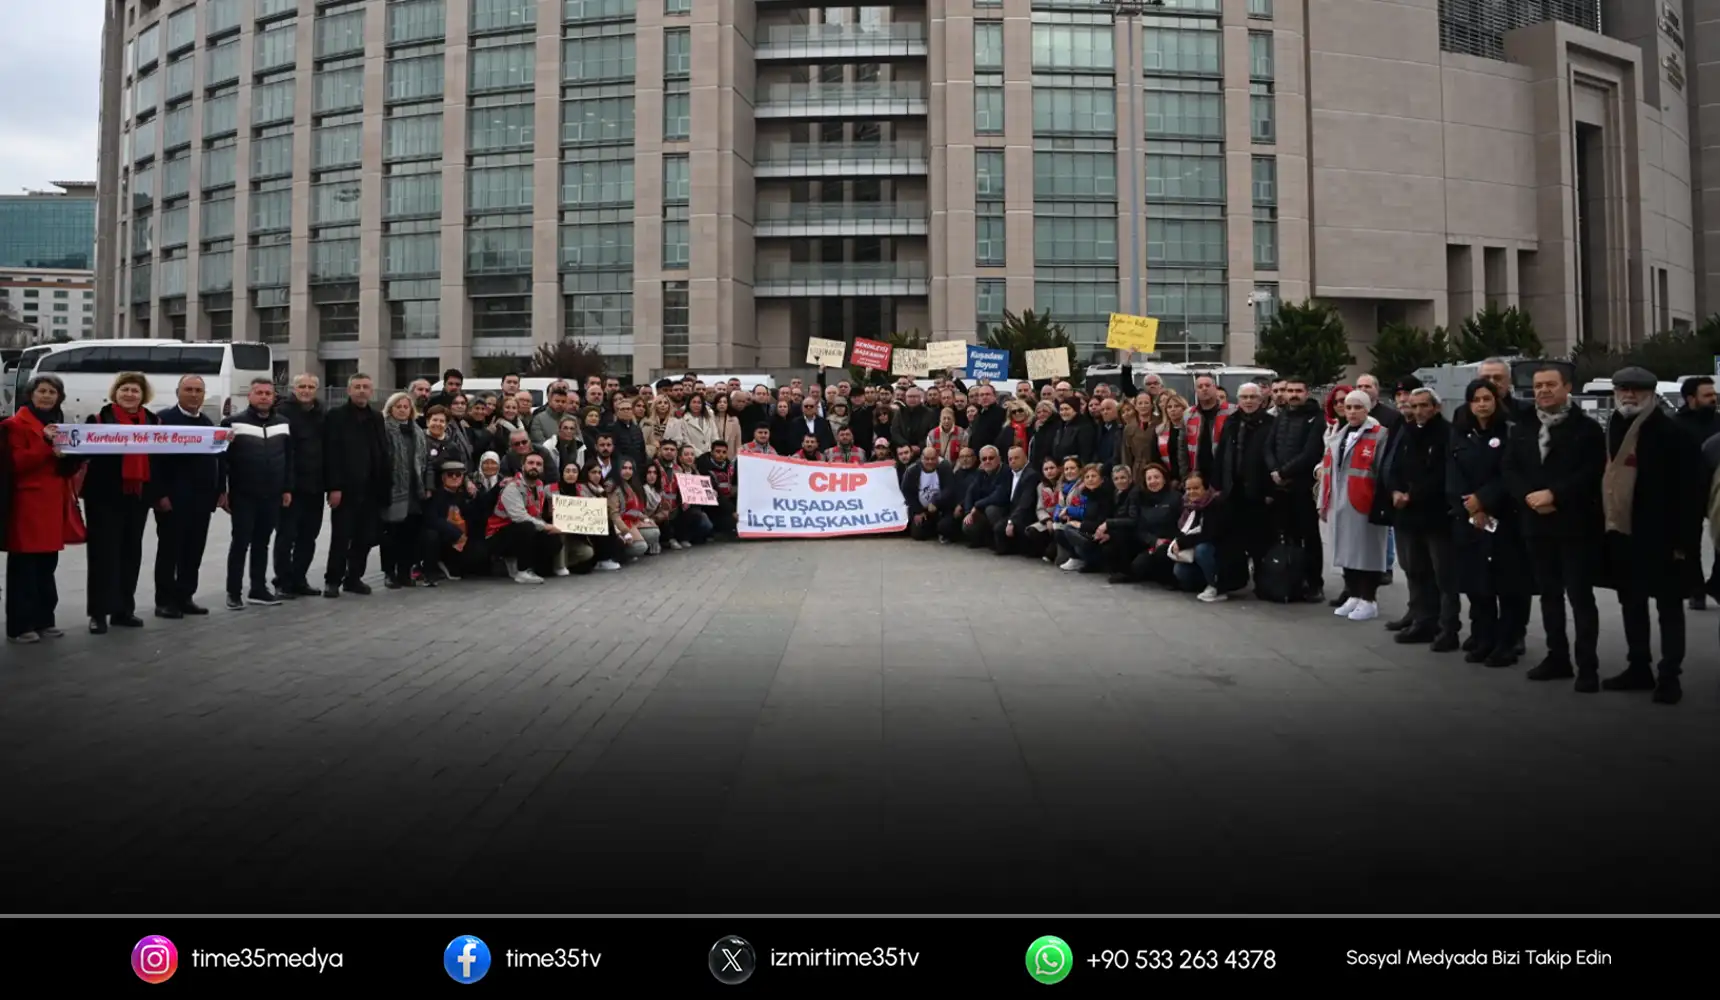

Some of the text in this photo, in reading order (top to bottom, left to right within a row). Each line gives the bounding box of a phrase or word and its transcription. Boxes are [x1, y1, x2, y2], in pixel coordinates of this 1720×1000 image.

[974, 361, 998, 370] Boyun
[86, 432, 128, 446] Kurtuluş
[132, 432, 149, 443] Yok
[153, 432, 168, 443] Tek
[171, 433, 202, 445] Başına
[808, 471, 868, 492] CHP
[772, 498, 864, 515] KUŞADASI
[747, 508, 900, 531] İLÇE BAŞKANLIĞI
